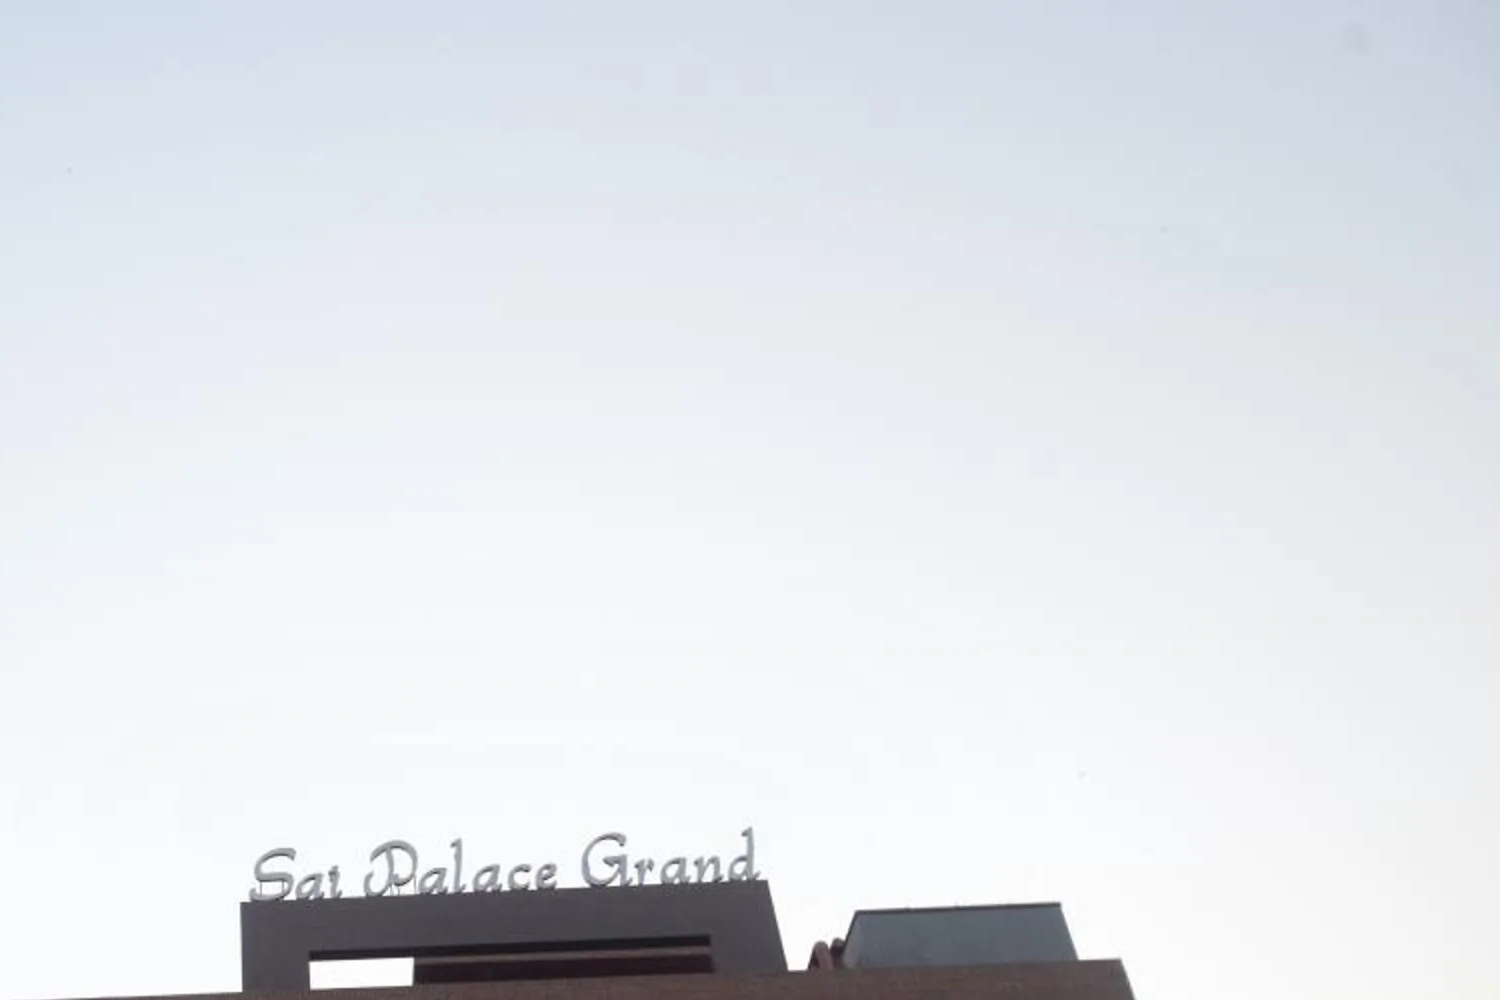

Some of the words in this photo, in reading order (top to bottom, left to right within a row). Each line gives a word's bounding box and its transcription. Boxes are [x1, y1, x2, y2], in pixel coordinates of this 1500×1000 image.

[249, 846, 343, 901] Sai
[363, 838, 559, 897] Palace
[581, 827, 761, 887] Grand
